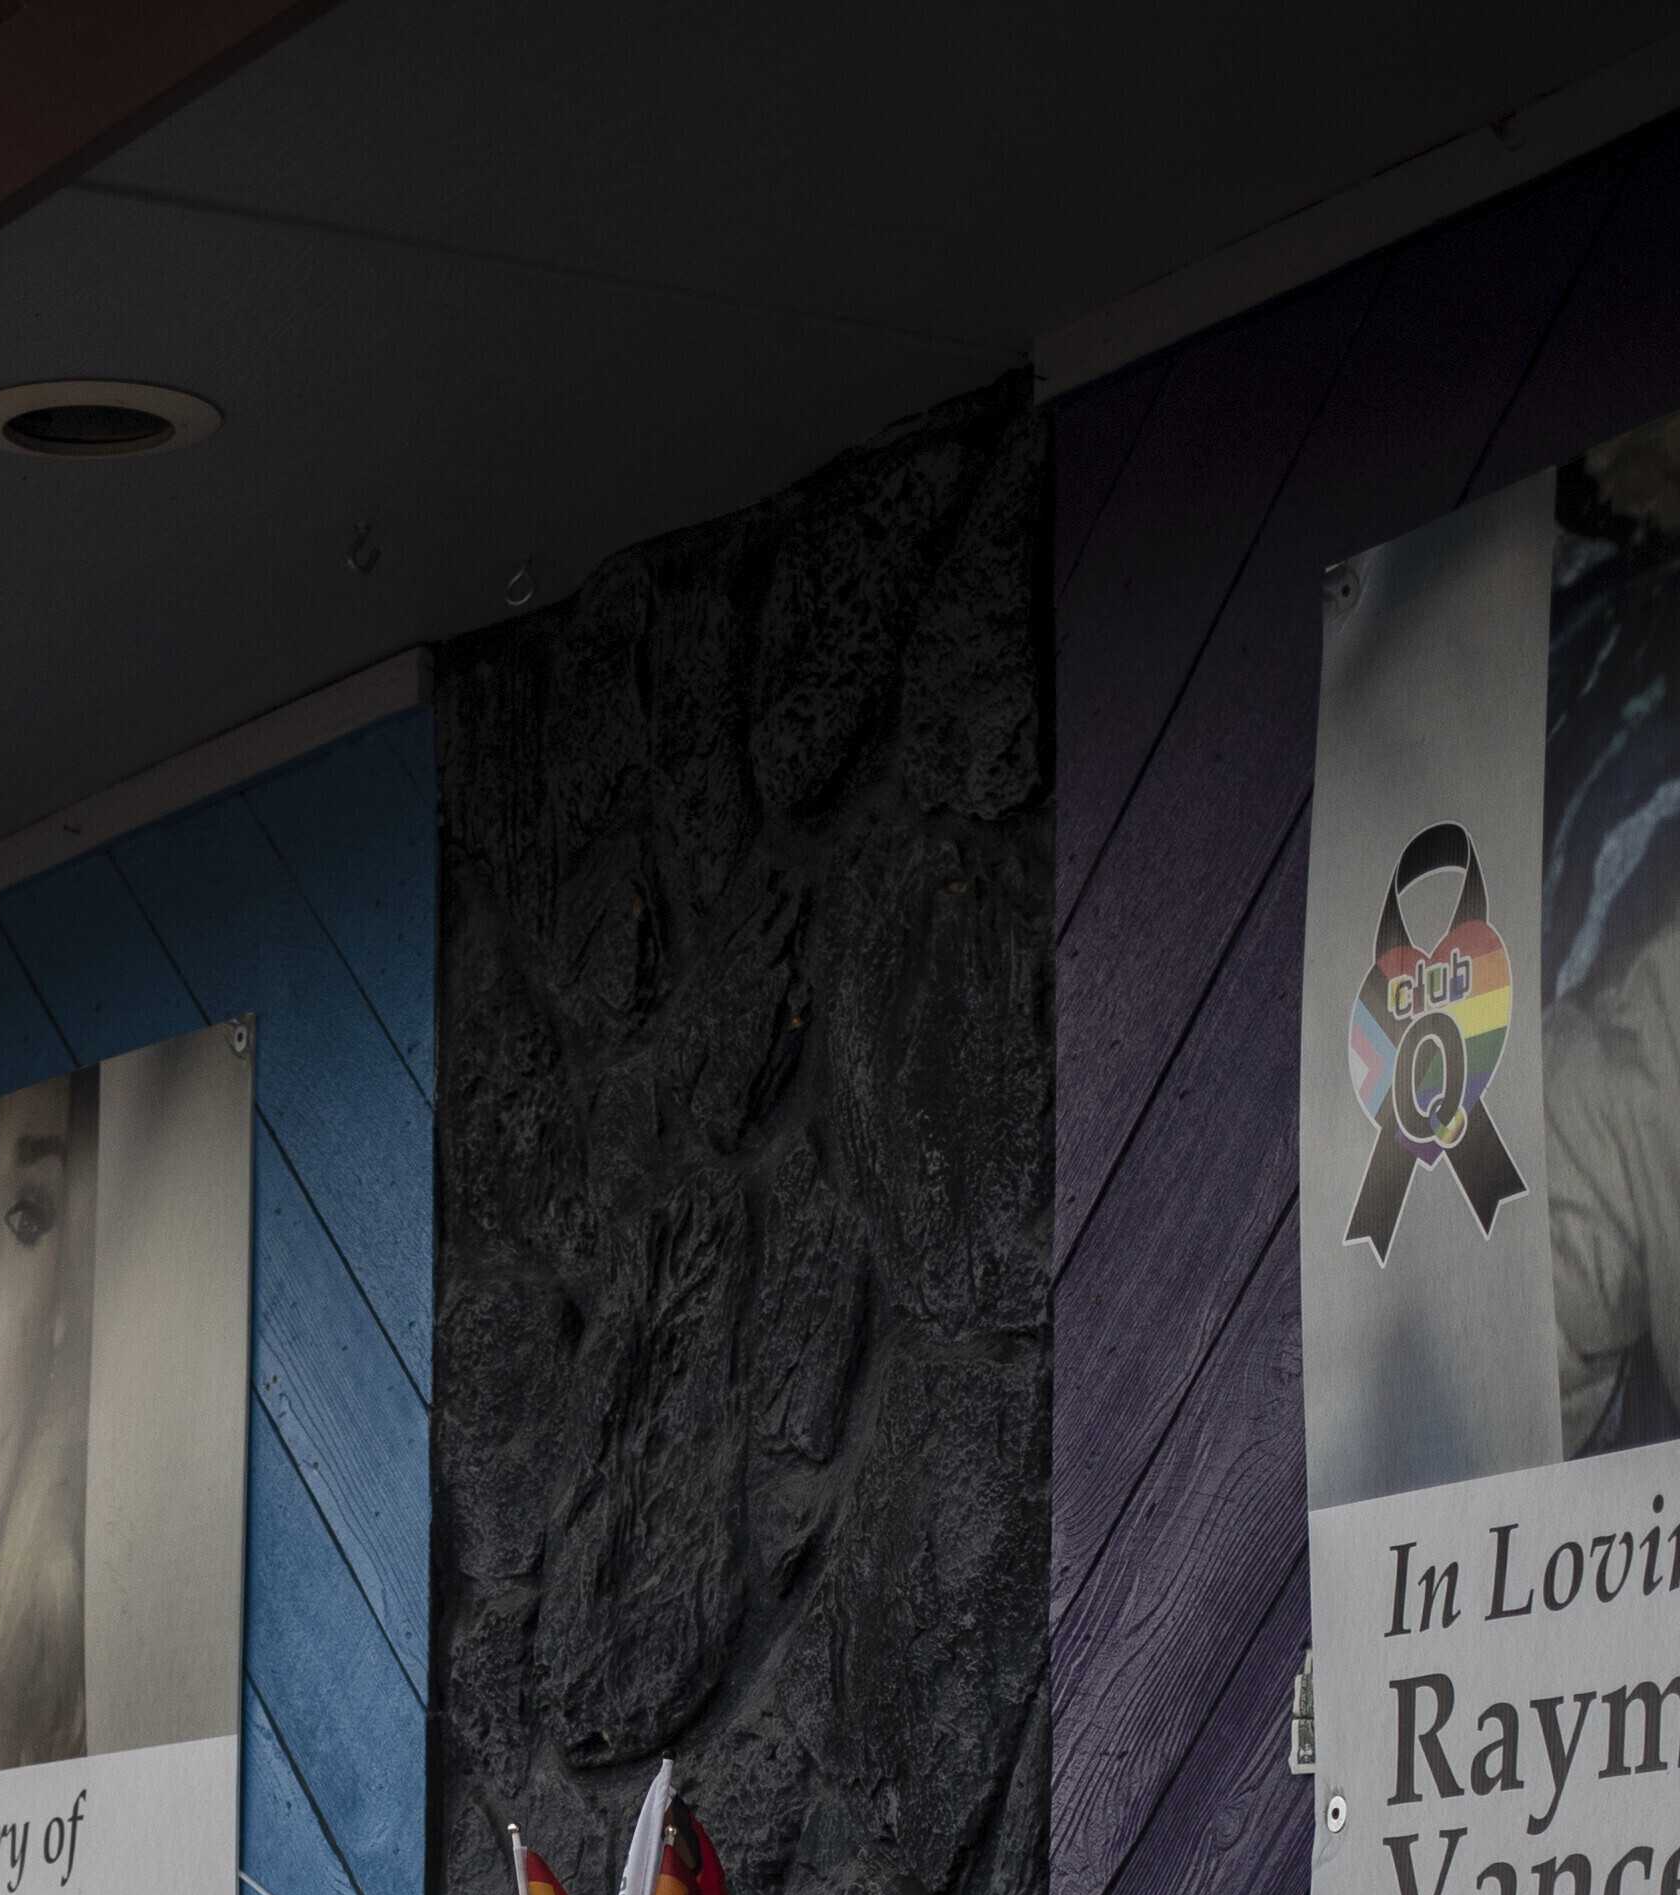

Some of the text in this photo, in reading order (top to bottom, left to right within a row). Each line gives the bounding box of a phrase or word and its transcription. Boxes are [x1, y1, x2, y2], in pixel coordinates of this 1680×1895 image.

[1393, 952, 1470, 1018] club
[1394, 1012, 1466, 1148] Q
[1384, 1542, 1461, 1638] In
[43, 1789, 87, 1887] of
